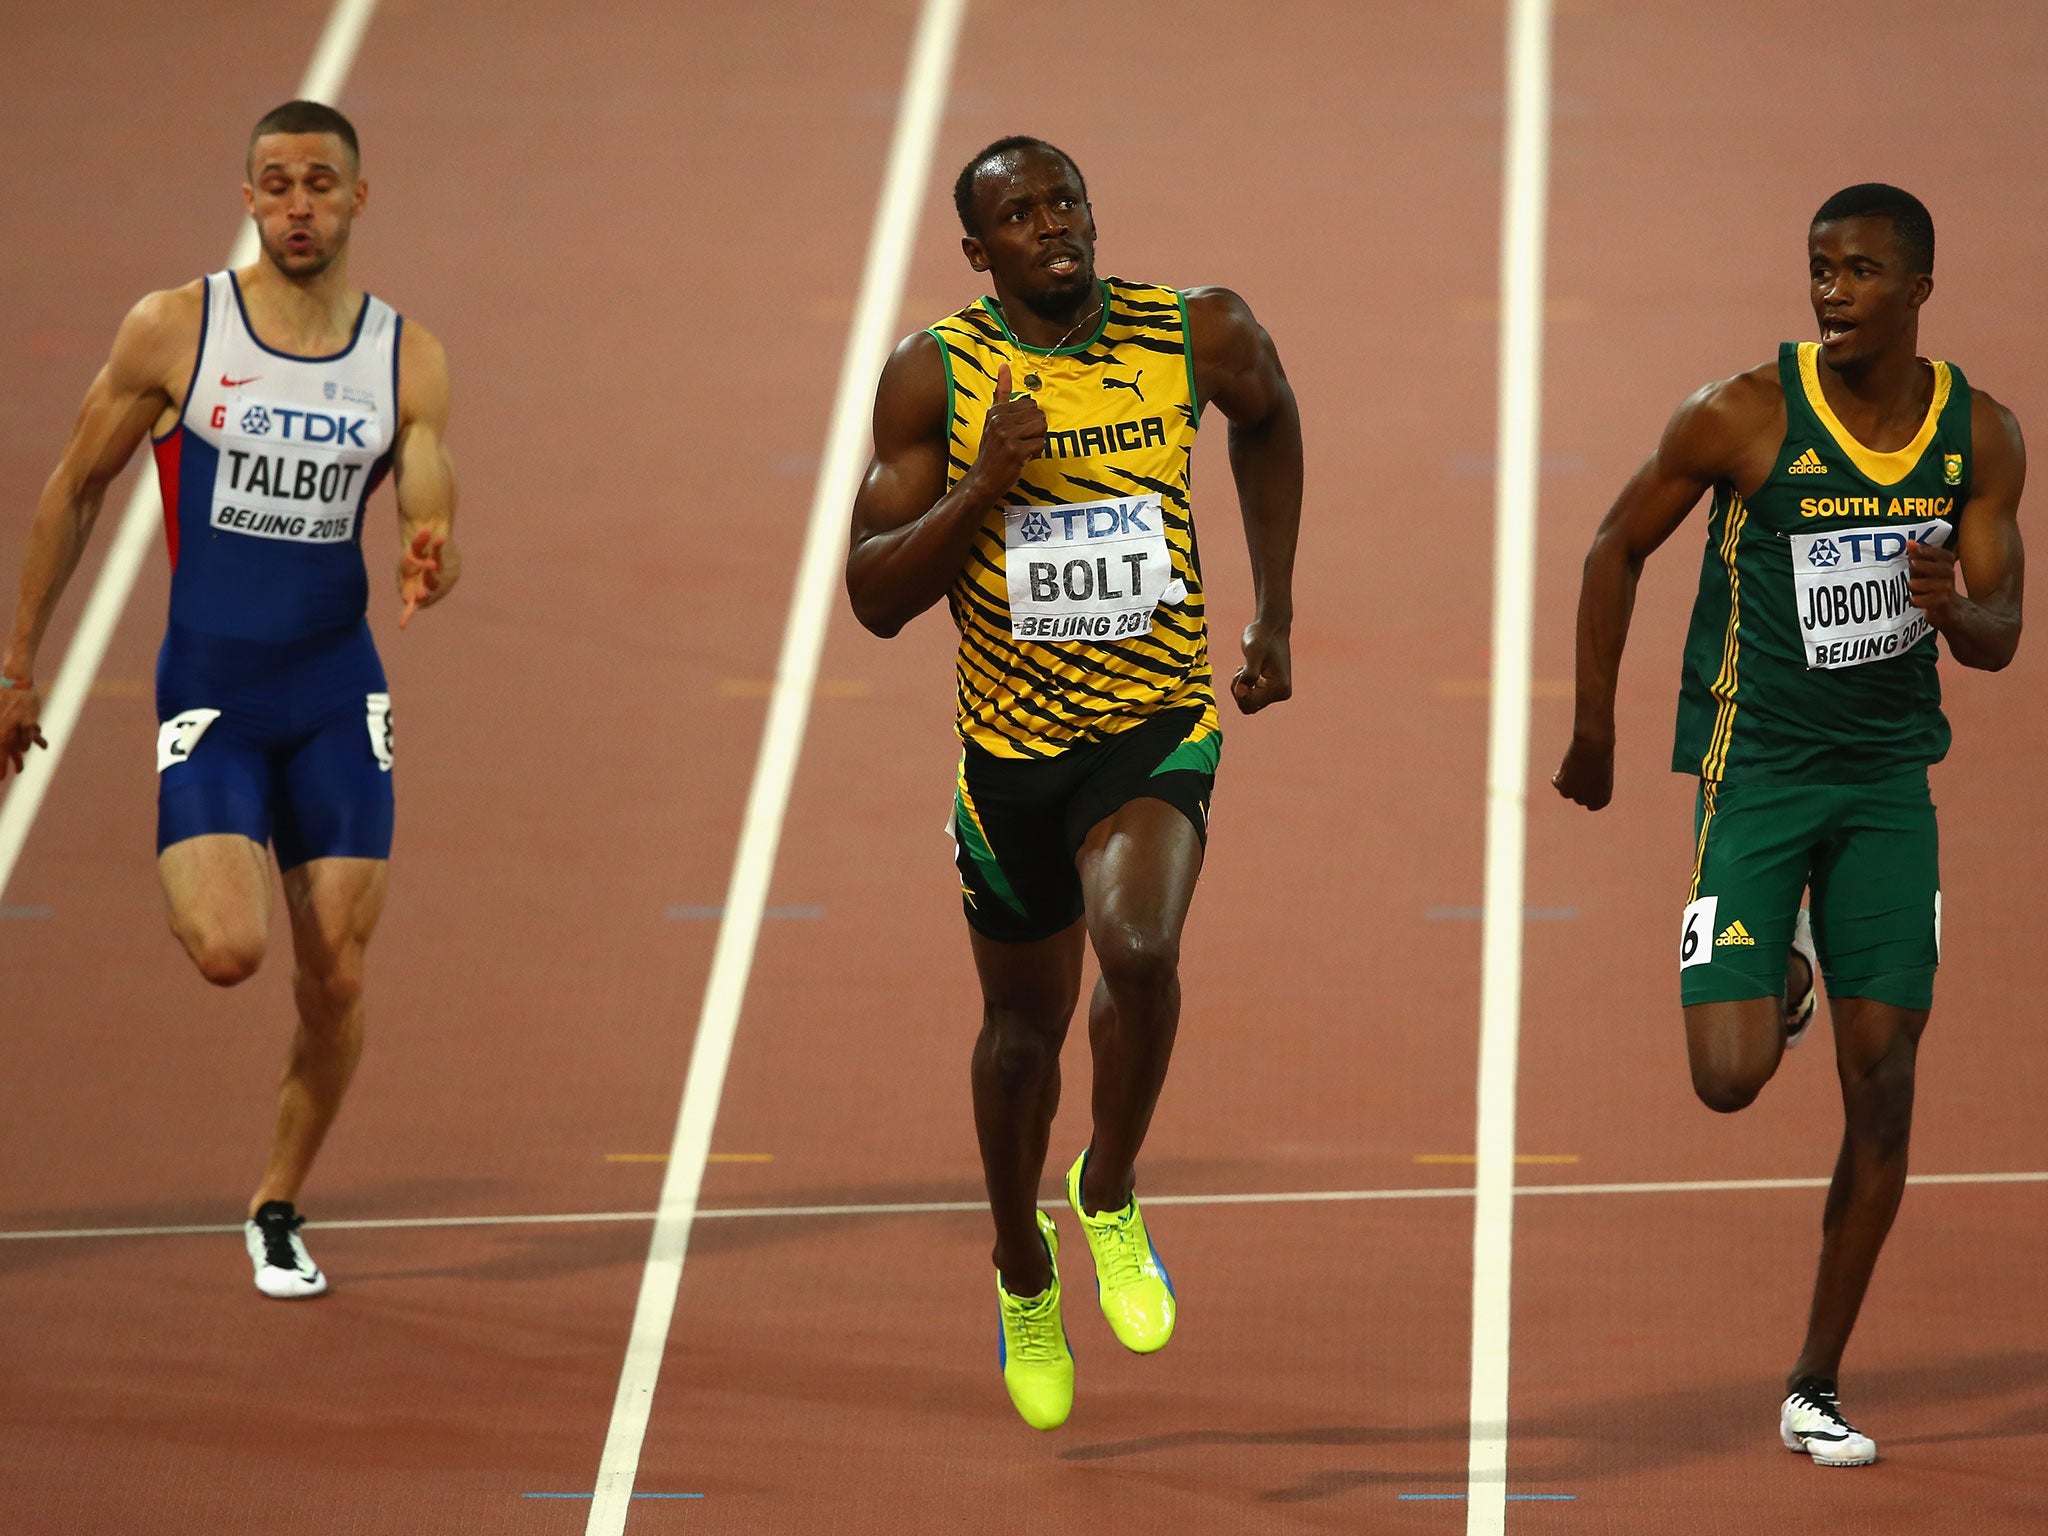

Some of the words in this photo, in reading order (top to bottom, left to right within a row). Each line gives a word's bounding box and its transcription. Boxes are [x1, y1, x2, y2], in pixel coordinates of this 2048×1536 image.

[273, 408, 366, 448] TDK
[1040, 416, 1167, 459] MAICA
[228, 450, 362, 504] TALBOT
[1788, 463, 1828, 474] adidas
[218, 506, 305, 537] BEIJING
[308, 517, 349, 539] 2015
[1051, 500, 1151, 541] TDK
[1800, 497, 1880, 518] SOUTH
[1029, 552, 1149, 602] BOLT
[1803, 568, 1912, 631] JOBODWA
[1021, 616, 1111, 638] BEIJING
[1115, 610, 1153, 636] 201
[1815, 633, 1898, 665] BEIJING
[1681, 912, 1699, 962] 6
[1715, 935, 1755, 947] adidas
